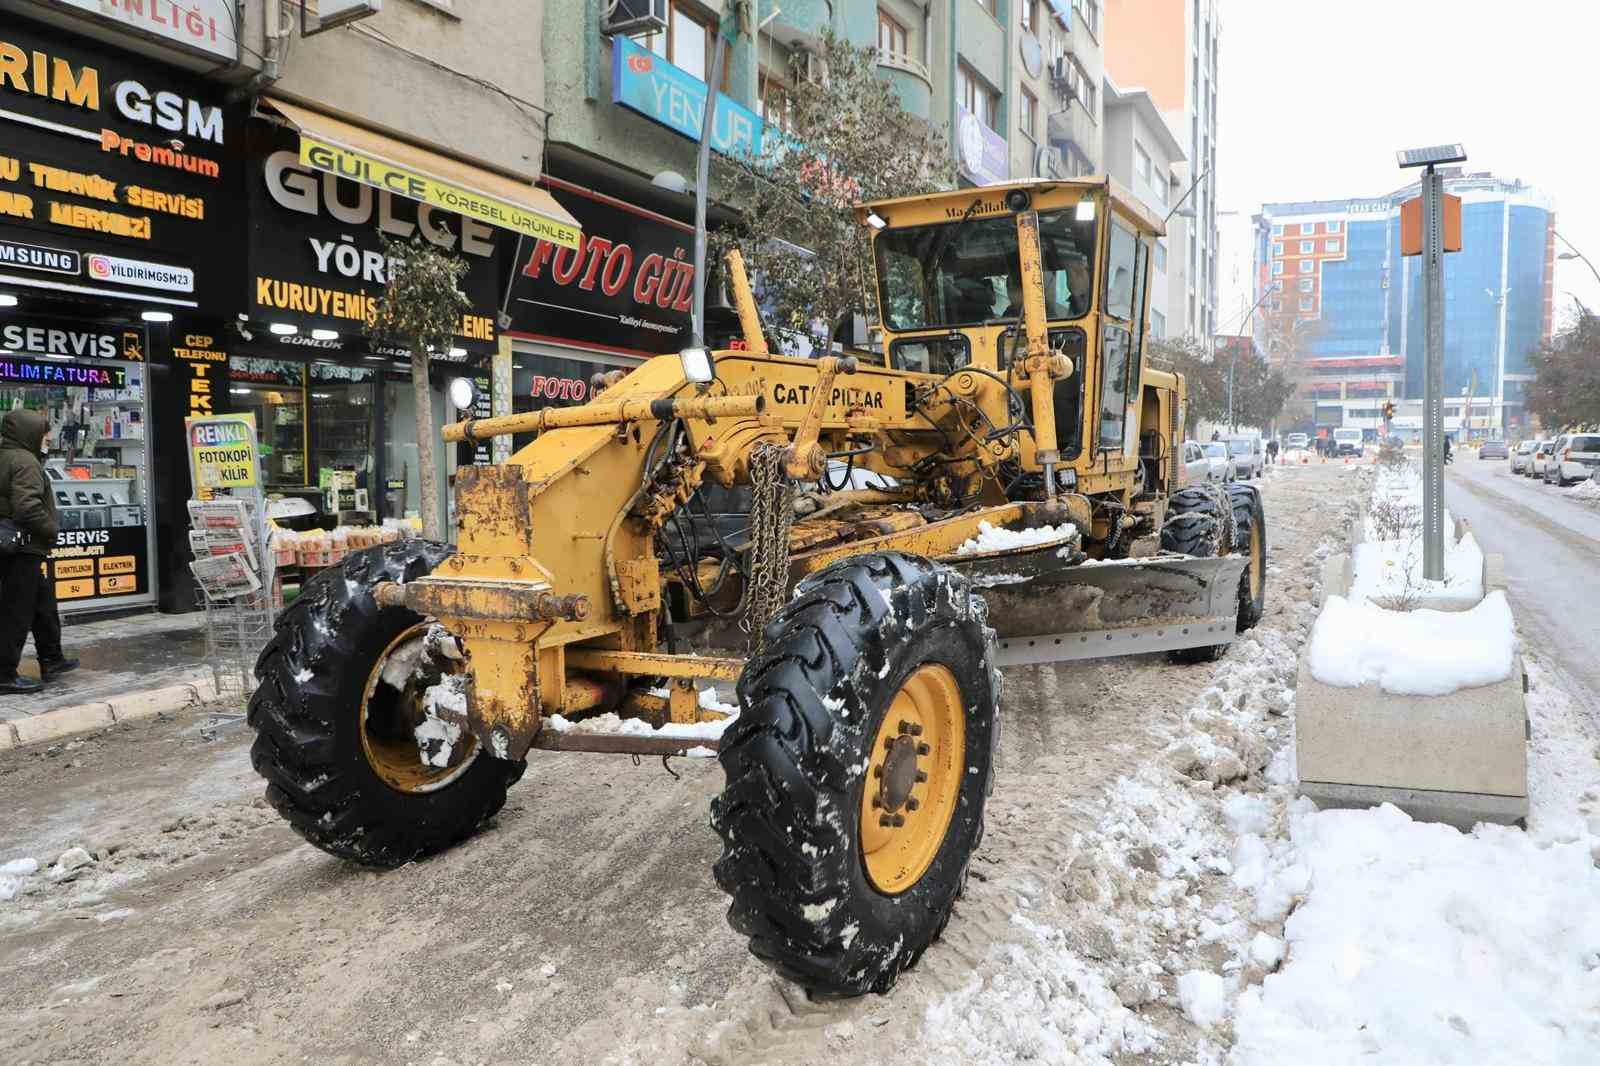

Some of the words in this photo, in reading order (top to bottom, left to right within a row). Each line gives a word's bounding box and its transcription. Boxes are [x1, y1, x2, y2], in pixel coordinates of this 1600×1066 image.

[109, 0, 217, 42] NLIĞI
[0, 41, 100, 111] RIM
[114, 79, 224, 145] GSM
[651, 75, 704, 130] YEN
[101, 128, 220, 178] Premium
[0, 155, 20, 182] U
[127, 185, 205, 220] SERVİSİ
[0, 245, 72, 270] MSUNG
[522, 231, 633, 297] FOTO
[256, 276, 378, 328] KURUYEMİŞ
[459, 312, 494, 341] EME
[3, 325, 117, 358] SERVİS
[173, 348, 227, 361] TELEFONU
[185, 334, 214, 348] CEP
[280, 335, 344, 350] GÜNLÜK
[44, 365, 111, 384] FATURA
[115, 370, 125, 385] T
[531, 375, 586, 401] FOTO
[773, 382, 884, 409] CATPILLAR
[199, 446, 252, 464] FOTOKOPİ
[56, 530, 109, 545] SERVİS
